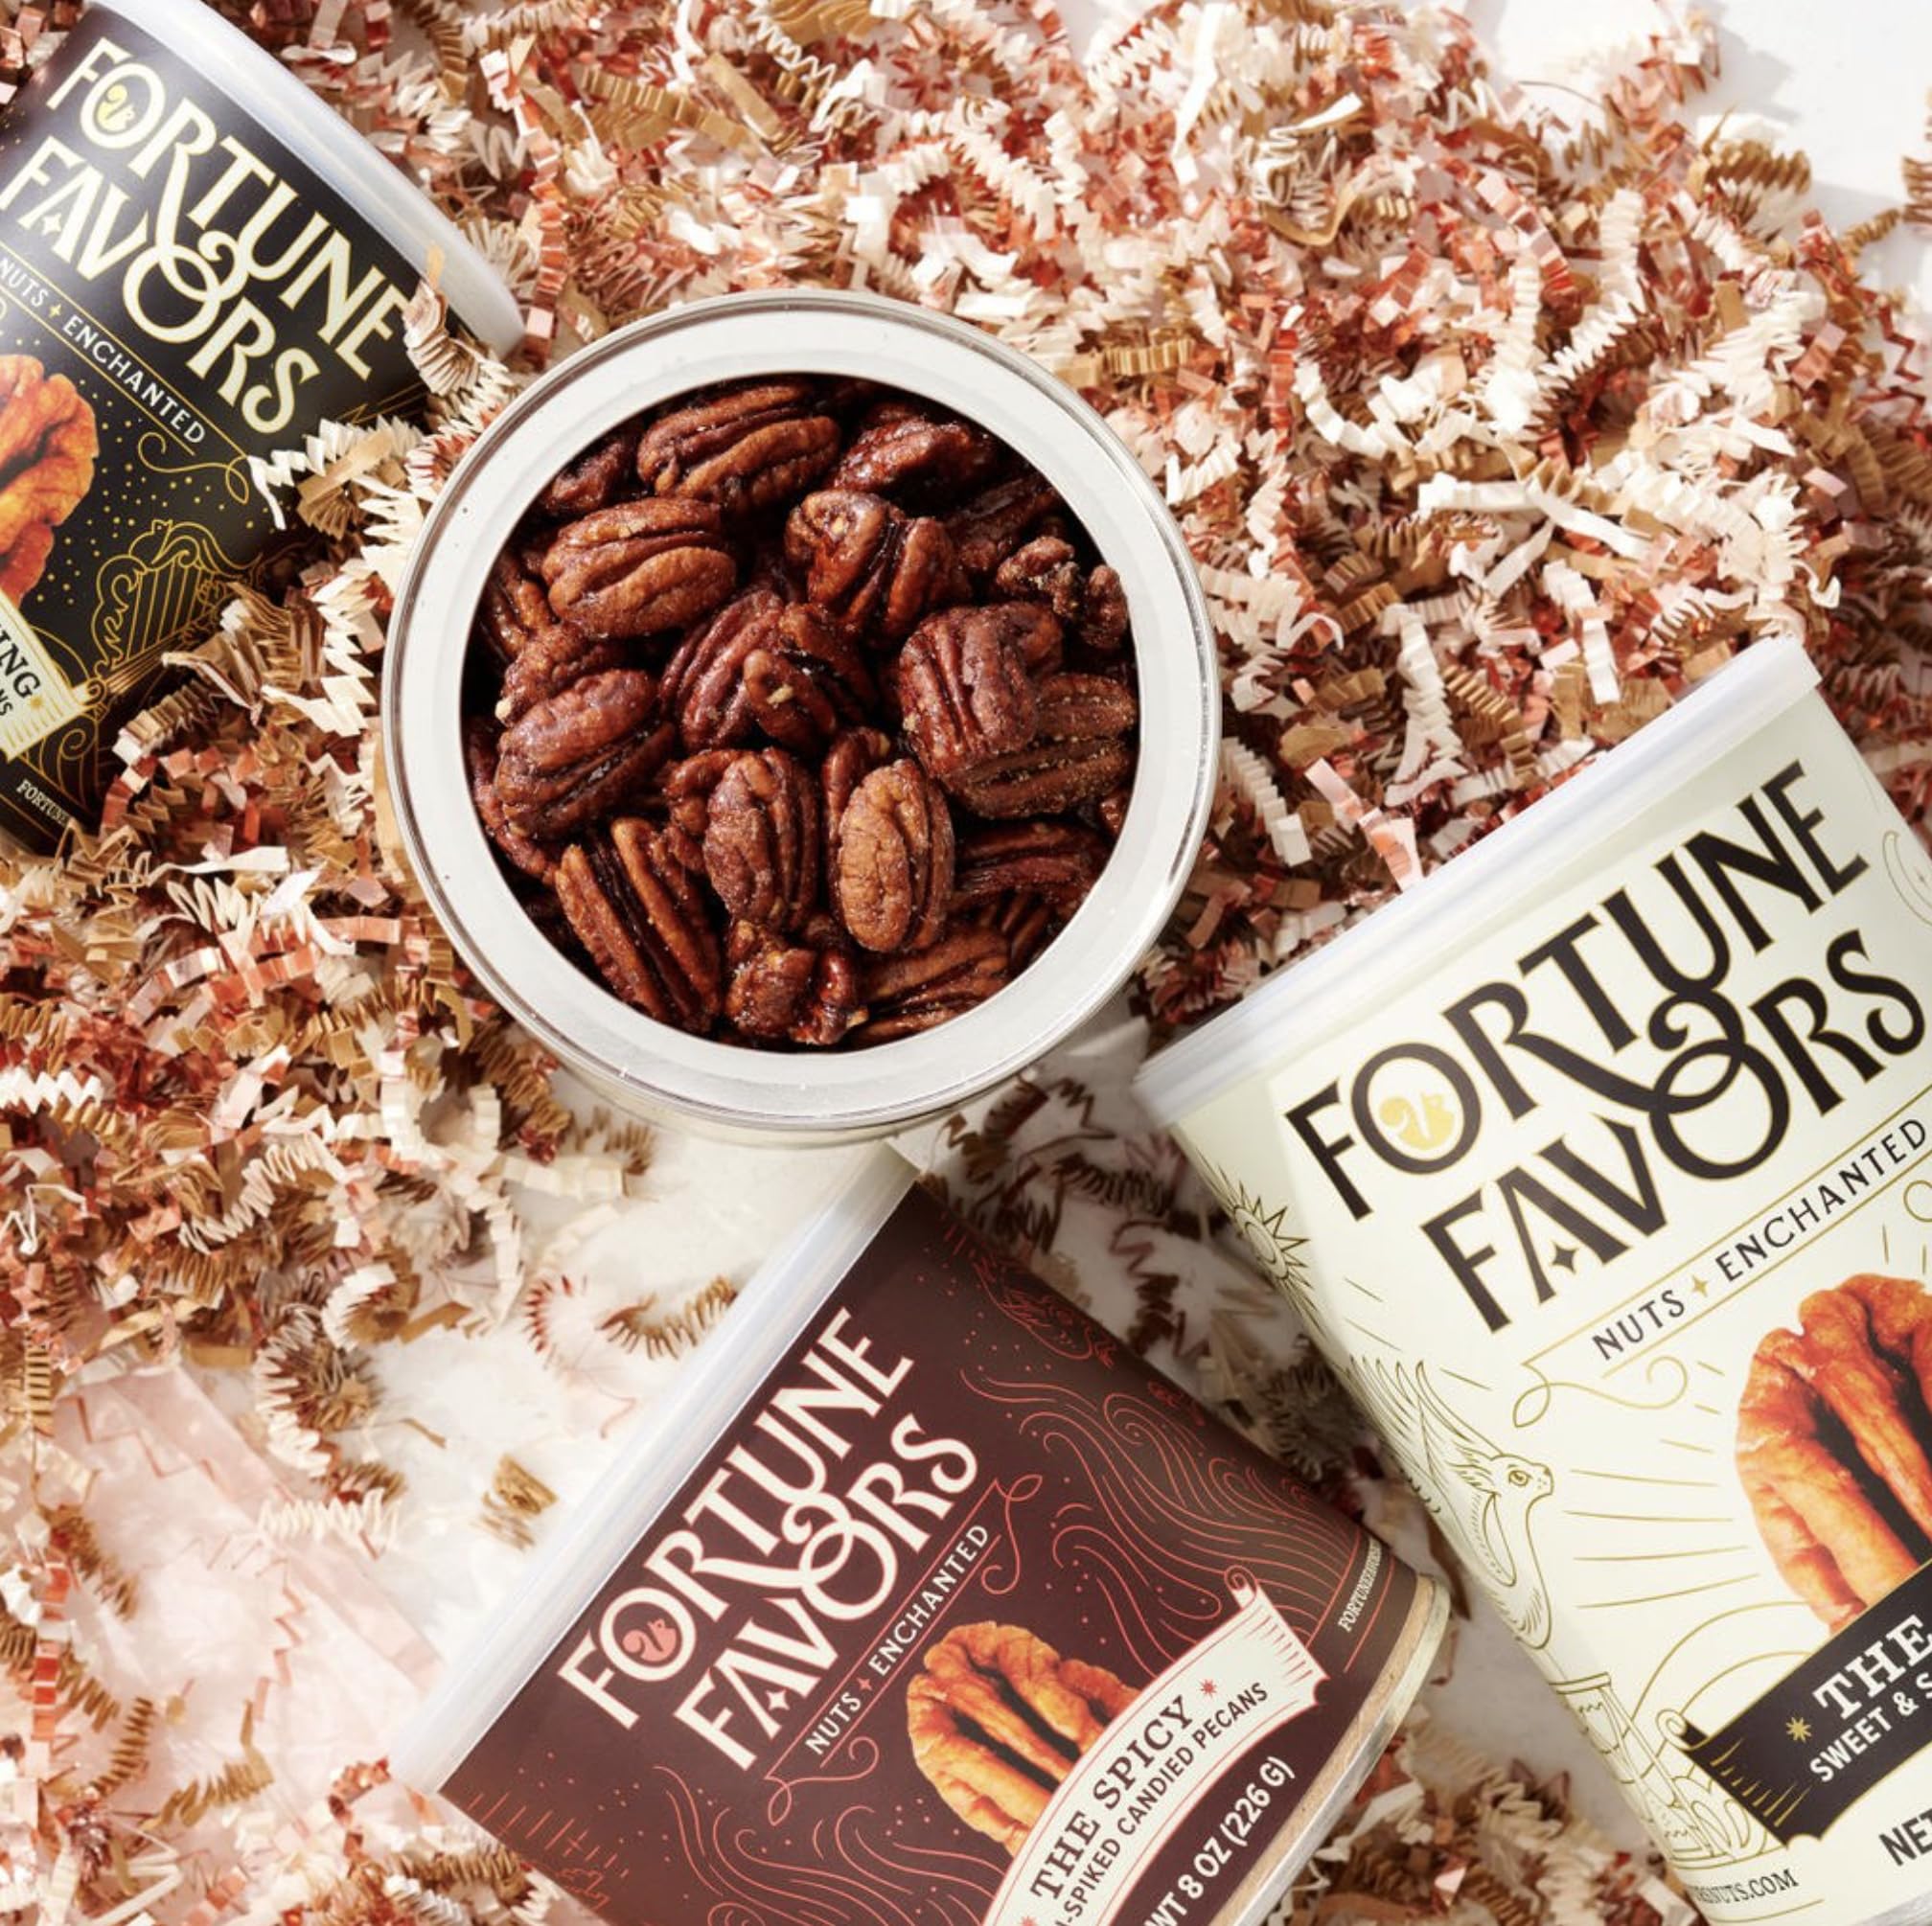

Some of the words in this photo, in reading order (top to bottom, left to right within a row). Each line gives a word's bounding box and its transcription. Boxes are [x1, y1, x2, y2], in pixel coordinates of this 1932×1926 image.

[0, 136, 320, 435] FAVORS
[46, 36, 410, 380] FORTUNE
[0, 256, 49, 308] NUTS
[62, 314, 206, 443] ENCHANTED
[1284, 760, 1870, 1222] FORTUNE
[1420, 929, 1926, 1334] FAVORS
[1591, 1289, 1686, 1361] NUTS
[1714, 1119, 1926, 1282] ENCHANTED
[557, 1308, 913, 1731] FORTUNE
[673, 1414, 978, 1771] FAVORS
[804, 1691, 862, 1754] NUTS
[868, 1525, 989, 1676] ENCHANTED
[1809, 1706, 1893, 1782] SWEET
[1892, 1690, 1920, 1717] &
[1812, 1614, 1932, 1720] THE
[1029, 1810, 1101, 1899] THE
[1092, 1694, 1193, 1811] SPICY
[1117, 1746, 1195, 1836] CANDIED
[1191, 1682, 1268, 1749] PECANS
[1177, 1873, 1205, 1899] 8
[1193, 1836, 1232, 1878] OZ
[1219, 1782, 1272, 1847] (226
[1258, 1755, 1296, 1787] G)
